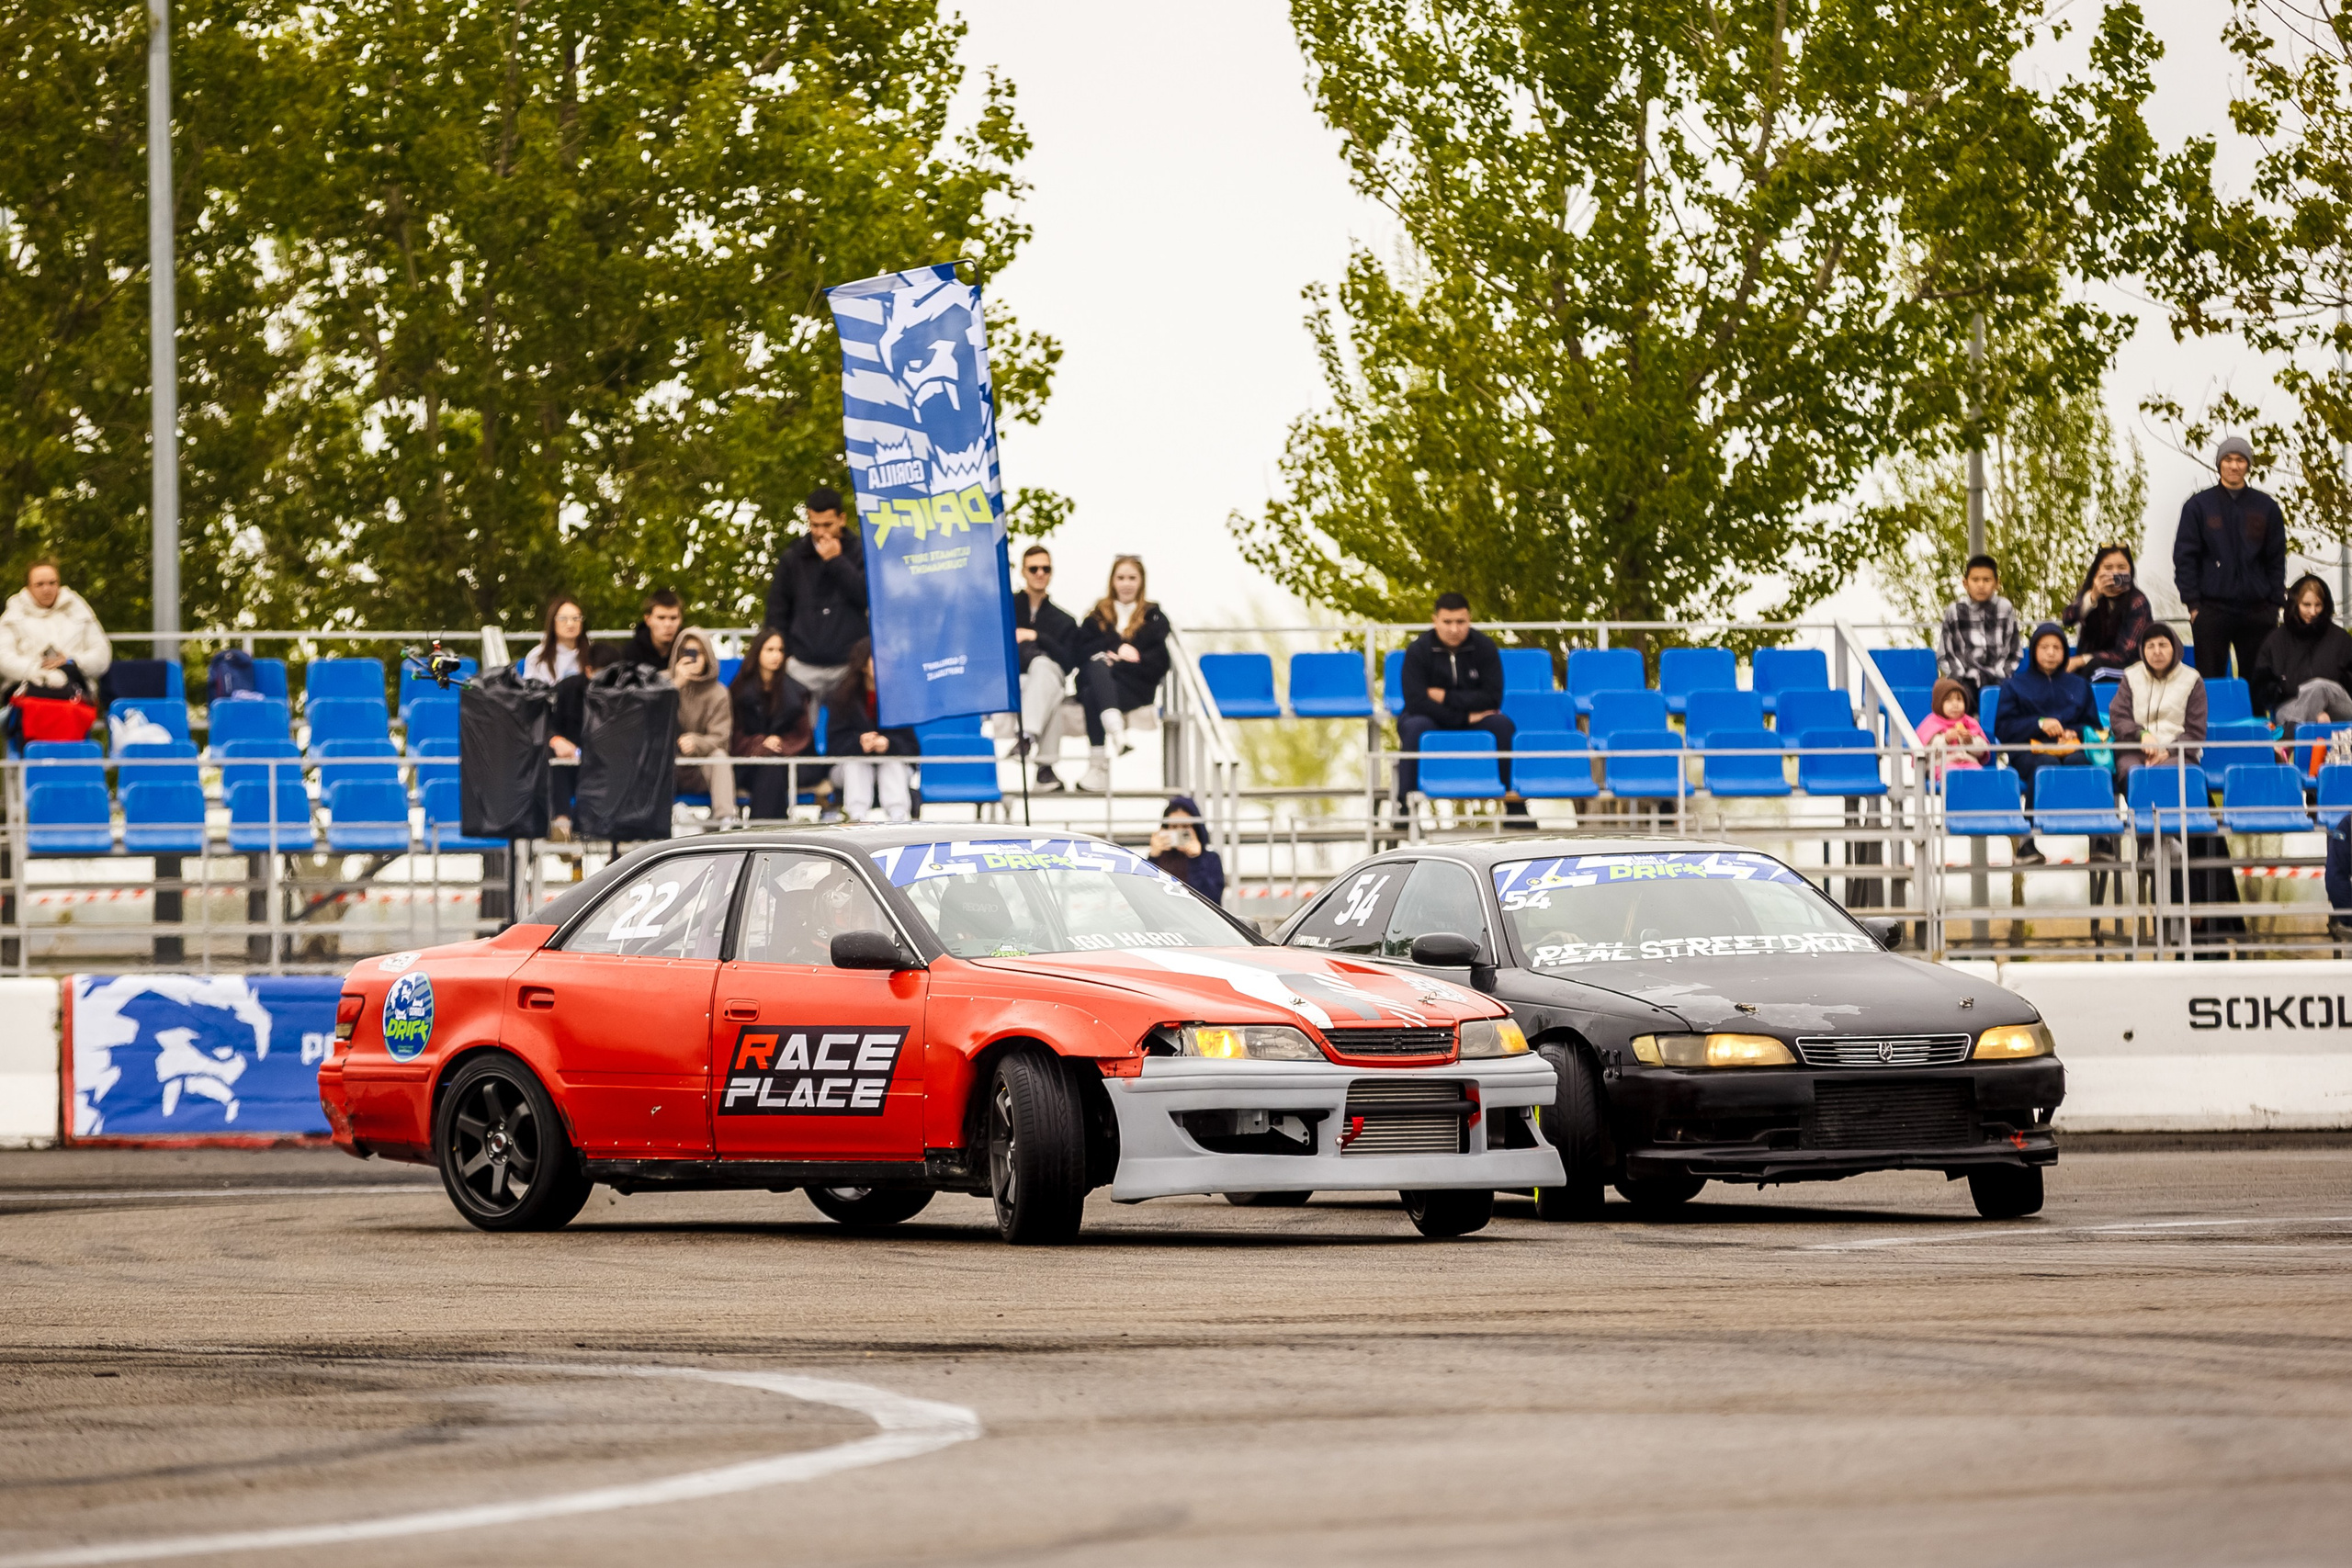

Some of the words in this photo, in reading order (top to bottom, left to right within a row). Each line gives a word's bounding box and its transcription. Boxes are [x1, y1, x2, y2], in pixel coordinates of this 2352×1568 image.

[982, 853, 1077, 870] DRIFT
[1610, 863, 1708, 879] DRIFT
[606, 880, 680, 942] 22
[962, 902, 999, 913] RECARO
[1334, 874, 1391, 927] 54
[1502, 890, 1552, 911] 54
[1114, 931, 1193, 947] HARD!
[1532, 942, 1635, 968] REAL
[386, 1018, 429, 1043] DRIFT
[735, 1033, 901, 1070] RACE
[724, 1077, 887, 1108] PLACE
